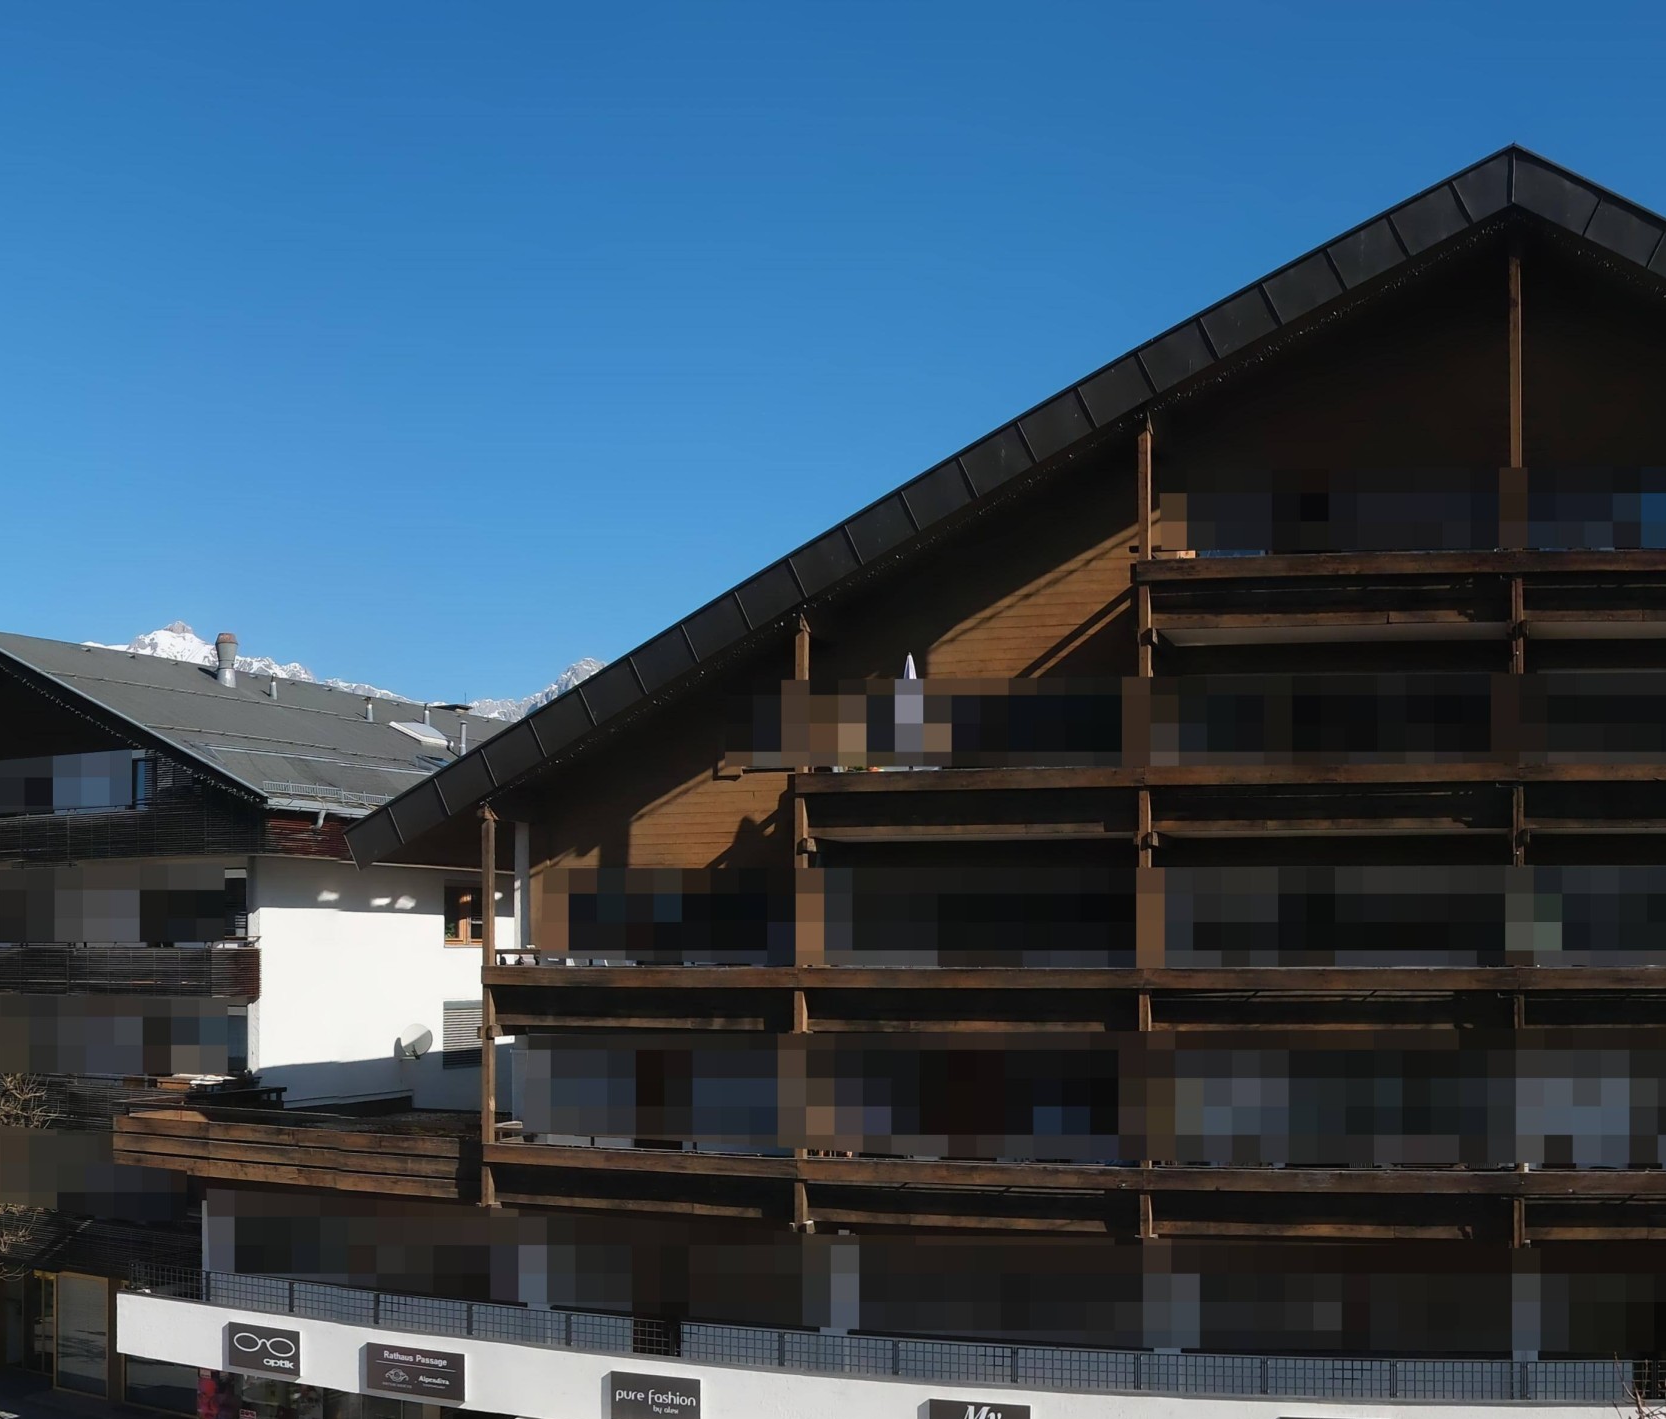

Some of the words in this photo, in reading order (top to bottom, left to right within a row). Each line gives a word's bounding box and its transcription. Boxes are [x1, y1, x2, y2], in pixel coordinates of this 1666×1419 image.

[263, 1357, 295, 1369] optik
[383, 1350, 414, 1362] Rathaus
[415, 1354, 448, 1367] Passage
[615, 1389, 645, 1402] pure
[648, 1389, 696, 1407] fashion
[652, 1404, 663, 1414] by
